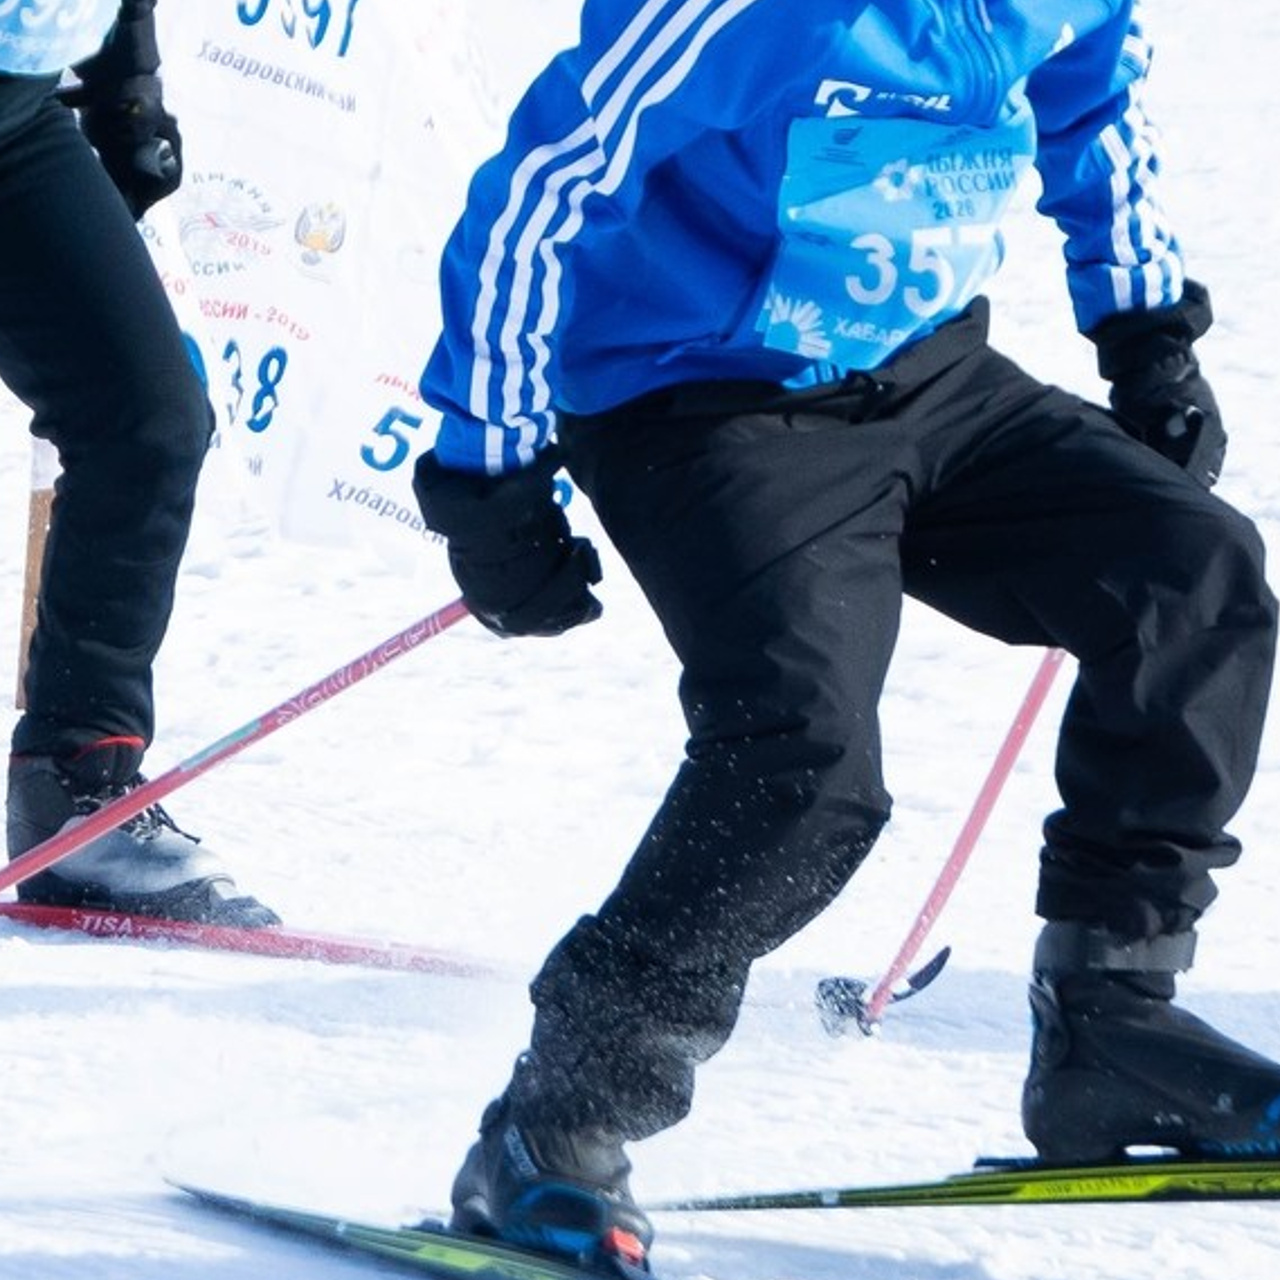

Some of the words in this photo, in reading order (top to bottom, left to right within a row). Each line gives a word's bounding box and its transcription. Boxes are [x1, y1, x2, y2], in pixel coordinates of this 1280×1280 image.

[267, 306, 310, 342] 2019
[360, 405, 423, 472] 5
[81, 914, 133, 934] TISA
